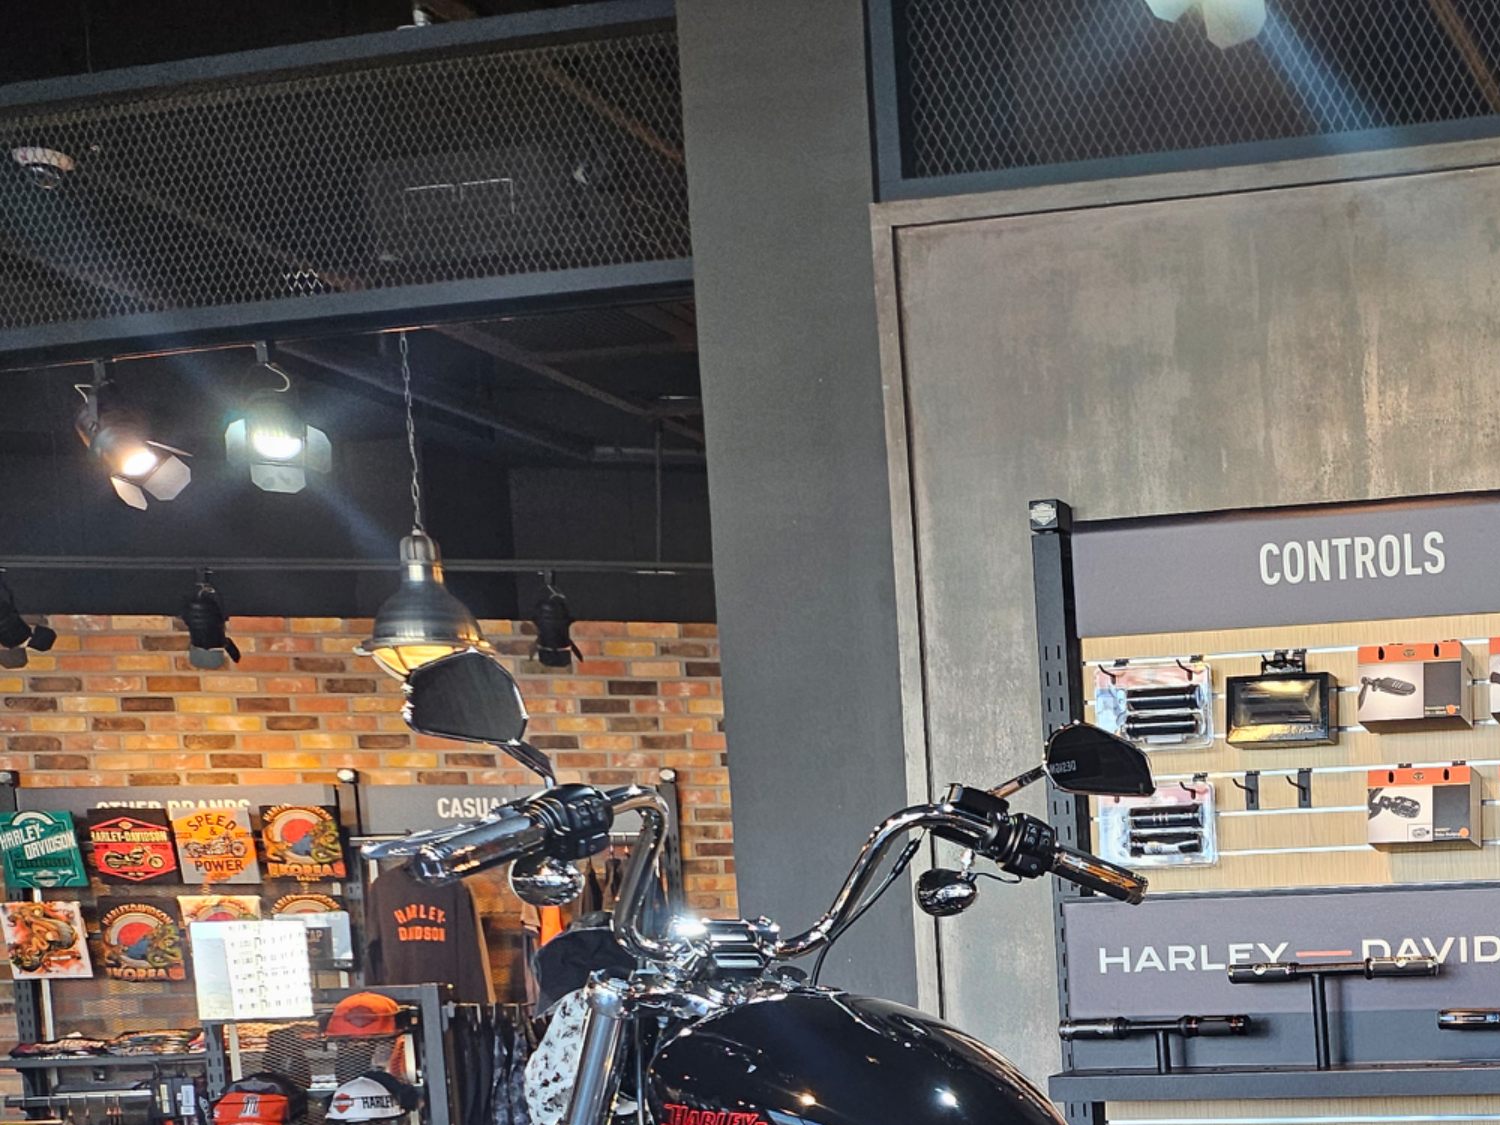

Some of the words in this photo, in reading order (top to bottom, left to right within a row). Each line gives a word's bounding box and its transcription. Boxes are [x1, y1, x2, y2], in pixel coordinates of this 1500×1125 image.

[1259, 530, 1446, 586] CONTROLS
[187, 813, 237, 831] SPEED
[194, 860, 244, 873] POWER
[1099, 942, 1289, 974] HARLEY
